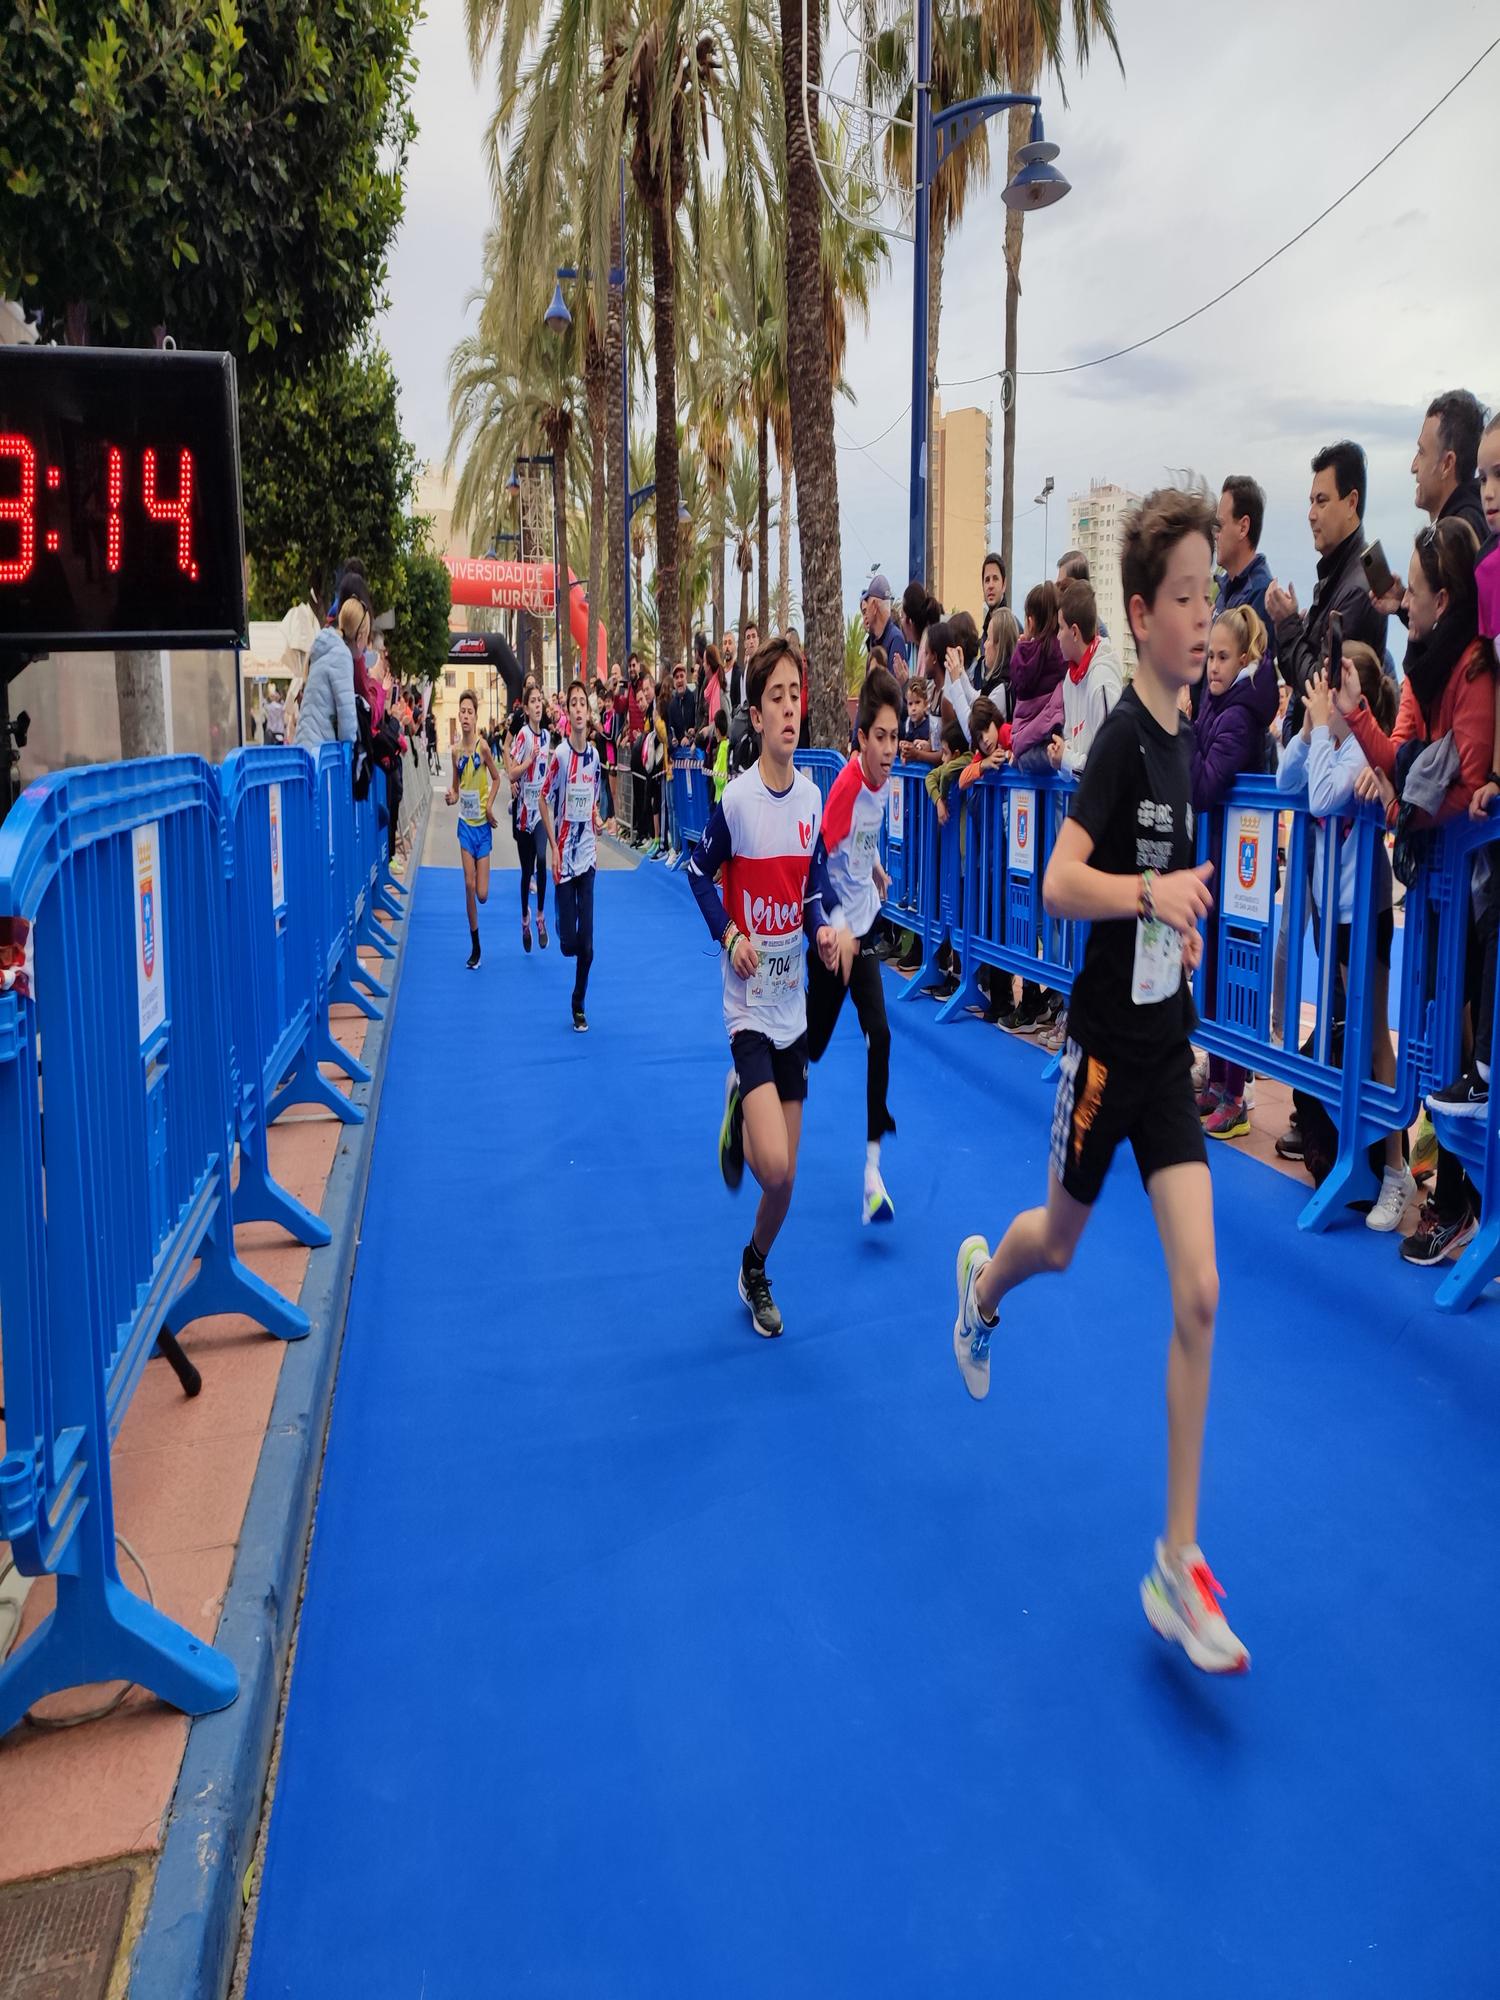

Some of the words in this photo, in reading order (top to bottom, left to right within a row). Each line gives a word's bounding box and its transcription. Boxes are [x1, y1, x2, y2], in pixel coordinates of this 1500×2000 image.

[446, 561, 522, 583] NIVERSIDAD
[527, 567, 543, 584] DE
[491, 588, 541, 608] MURCIA
[575, 797, 587, 808] 707
[768, 955, 791, 977] 704
